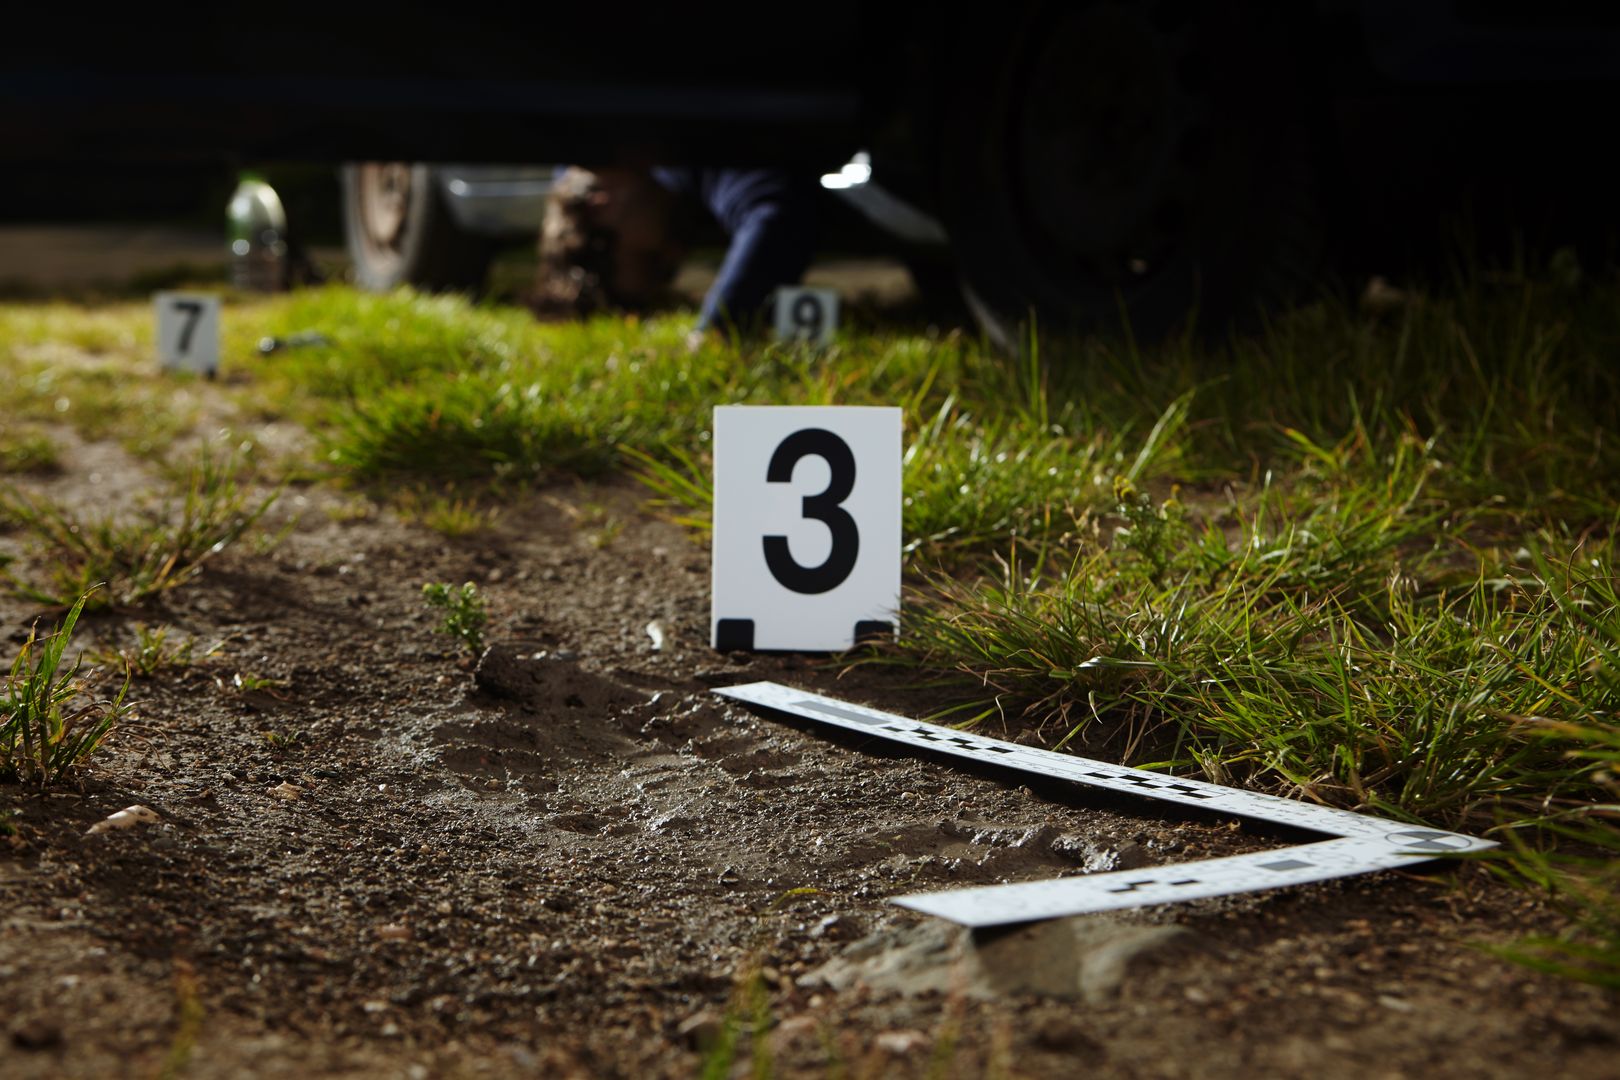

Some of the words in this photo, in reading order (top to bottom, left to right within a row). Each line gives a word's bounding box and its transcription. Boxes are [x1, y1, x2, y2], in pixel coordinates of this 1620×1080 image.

[172, 300, 203, 353] 7
[792, 293, 823, 342] 9
[762, 428, 859, 595] 3
